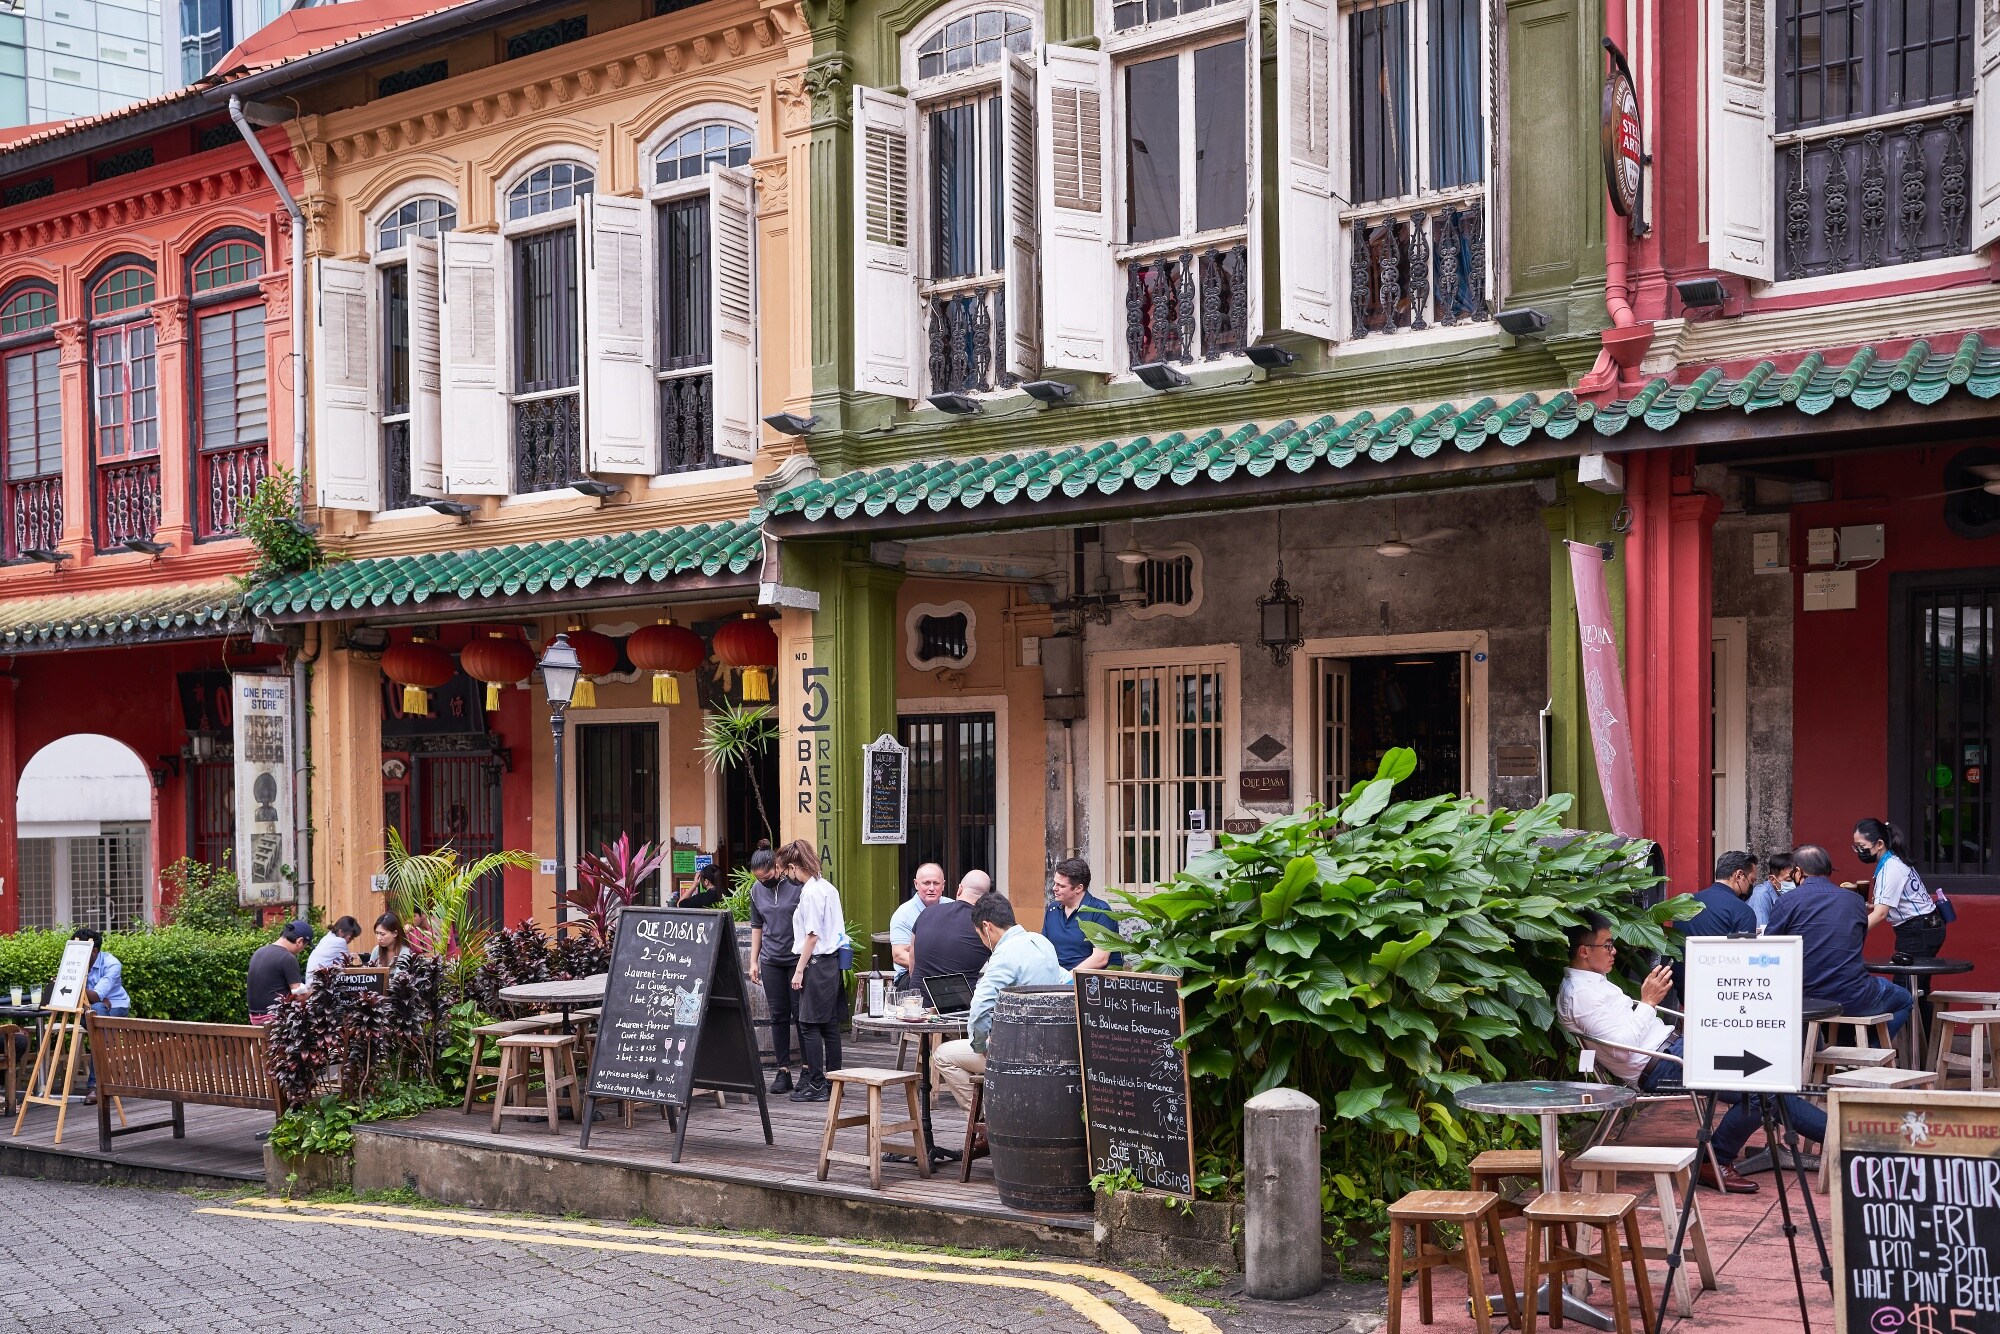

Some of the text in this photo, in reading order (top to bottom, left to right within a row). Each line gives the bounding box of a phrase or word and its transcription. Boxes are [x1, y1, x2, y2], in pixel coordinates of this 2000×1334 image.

[795, 653, 808, 661] NO
[243, 687, 284, 699] ONE PRICE
[802, 667, 829, 722] 5
[251, 699, 277, 710] STORE
[798, 739, 812, 814] BAR
[1242, 777, 1284, 789] QUE PASA
[818, 739, 833, 883] RESTA
[1228, 821, 1256, 833] OPEN
[636, 919, 694, 942] QUE PASA
[635, 980, 645, 990] La
[1104, 978, 1164, 994] EXPERIENCE
[1717, 978, 1771, 987] ENTRY TO
[634, 993, 646, 1004] bot
[1717, 991, 1773, 1002] QUE PASA
[1739, 1005, 1747, 1015] &
[1084, 1012, 1171, 1036] The Balvenie Experience
[1700, 1018, 1786, 1029] ICE-COLD BEER
[656, 1073, 663, 1081] to
[1087, 1068, 1098, 1082] The
[1136, 1077, 1175, 1093] Experience
[1848, 1120, 1901, 1136] LITTLE
[1109, 1144, 1166, 1168] QUE PASA
[1850, 1155, 2000, 1208] CRAZY HOUR
[1937, 1242, 1989, 1277] 3PM
[1853, 1269, 1895, 1300] HALF
[1903, 1269, 1949, 1304] PINT
